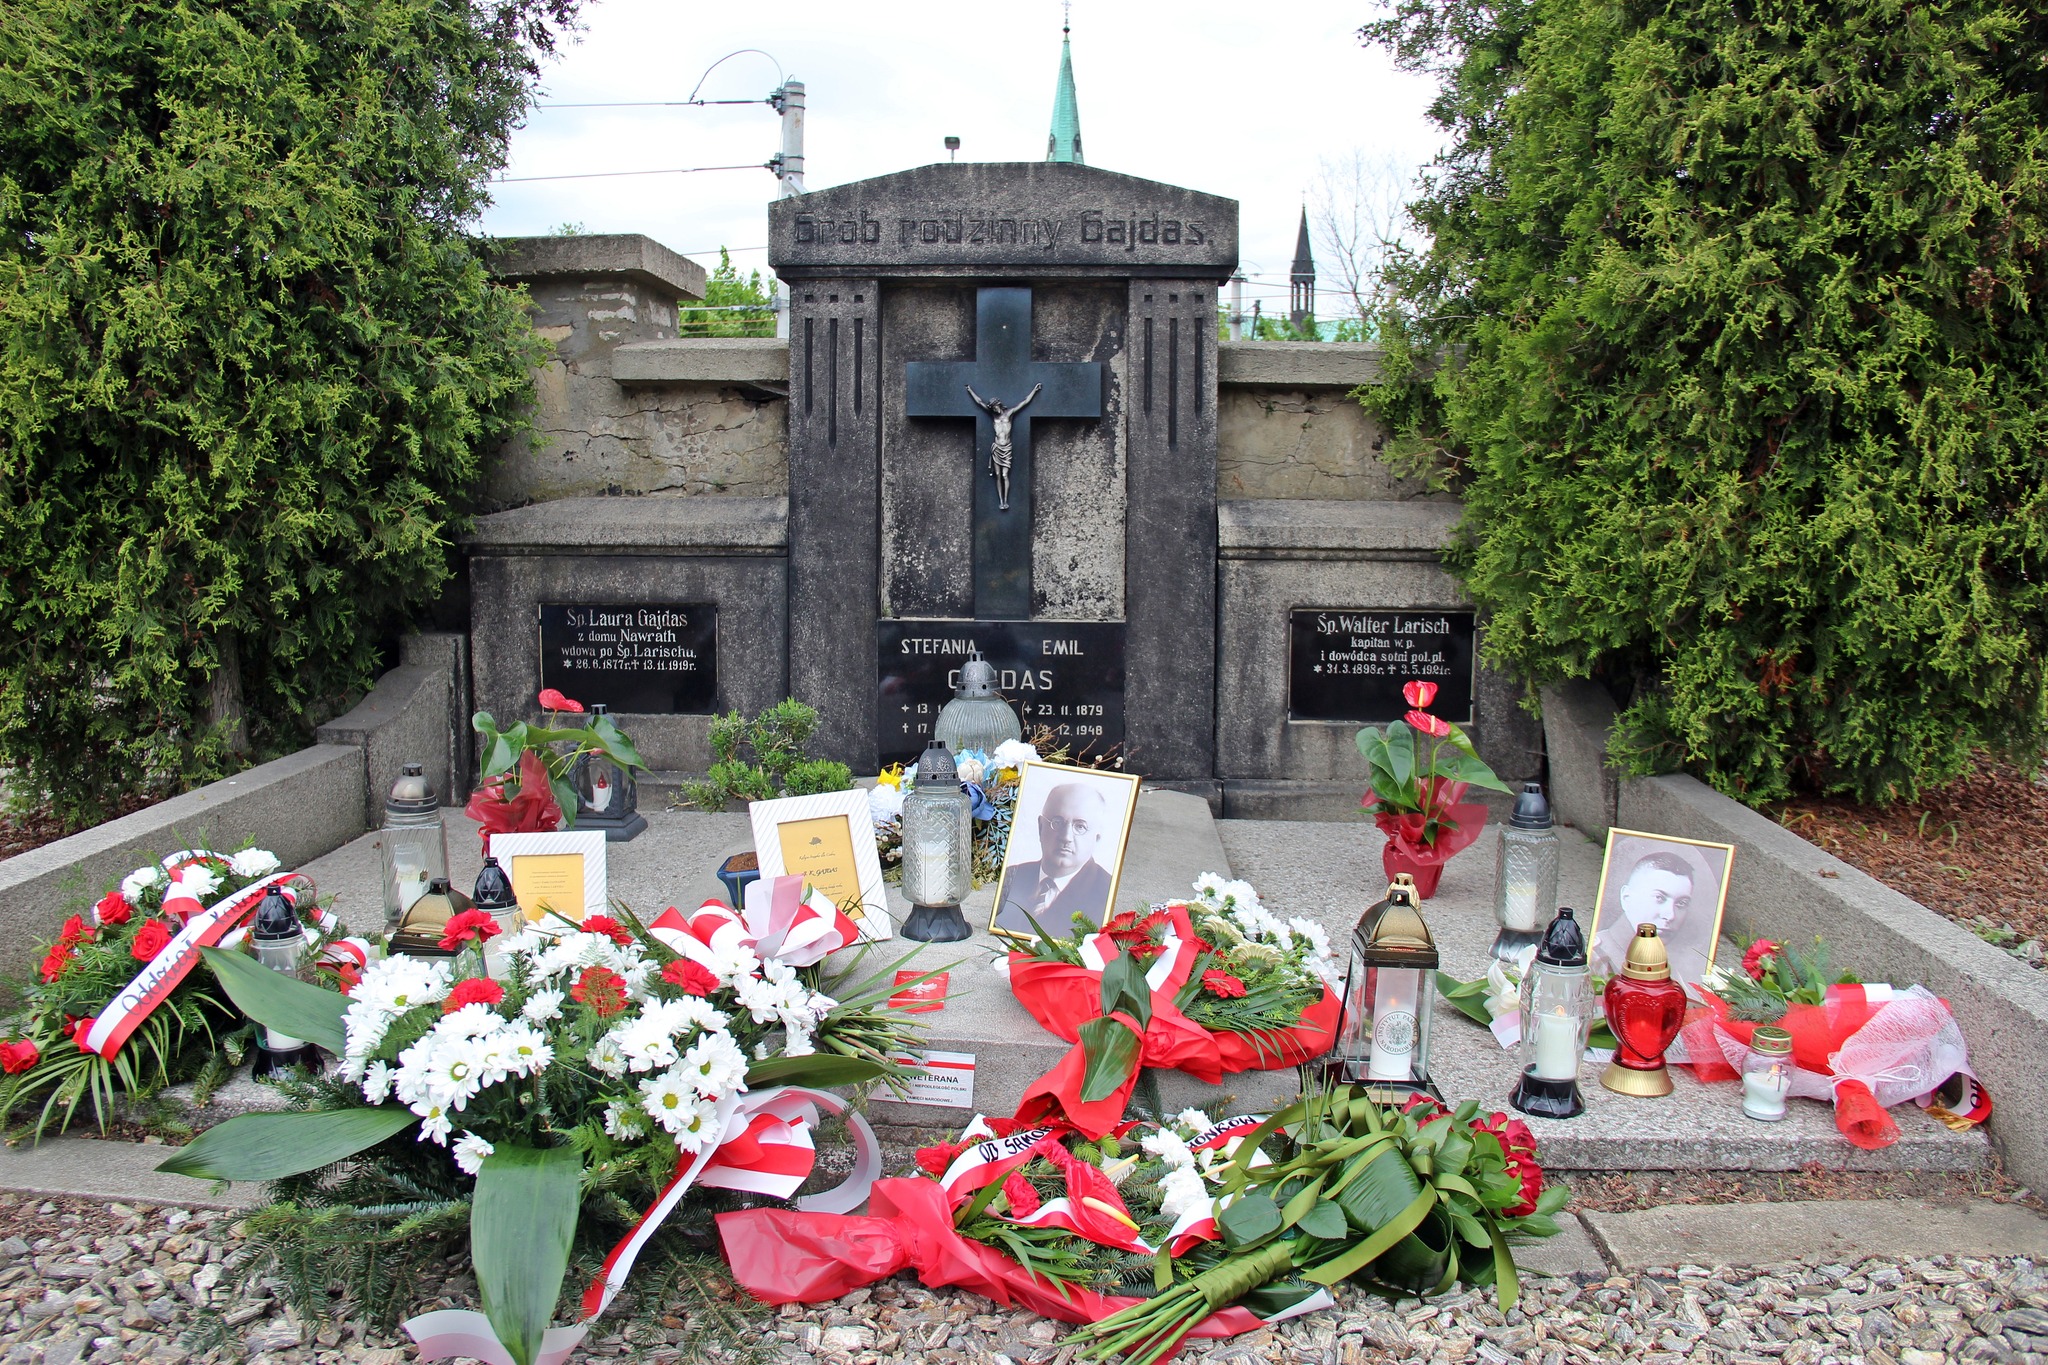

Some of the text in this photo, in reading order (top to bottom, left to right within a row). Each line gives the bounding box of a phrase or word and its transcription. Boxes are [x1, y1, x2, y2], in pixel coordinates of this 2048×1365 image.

[900, 210, 1062, 251] rodzinny
[589, 609, 633, 627] Laura
[638, 609, 688, 630] Gajdas
[1339, 615, 1390, 634] Walter
[1393, 615, 1450, 634] Larisch
[578, 629, 677, 643] z domu Nawrath
[901, 639, 1084, 656] STEFANIA EMIL
[1351, 637, 1390, 649] kapitan
[561, 646, 596, 657] wdowa
[599, 647, 613, 659] po
[1321, 650, 1325, 661] i
[1329, 650, 1377, 662] dowódca
[1038, 704, 1055, 716] 23.
[1076, 704, 1103, 716] 1879
[1076, 725, 1103, 736] 1948
